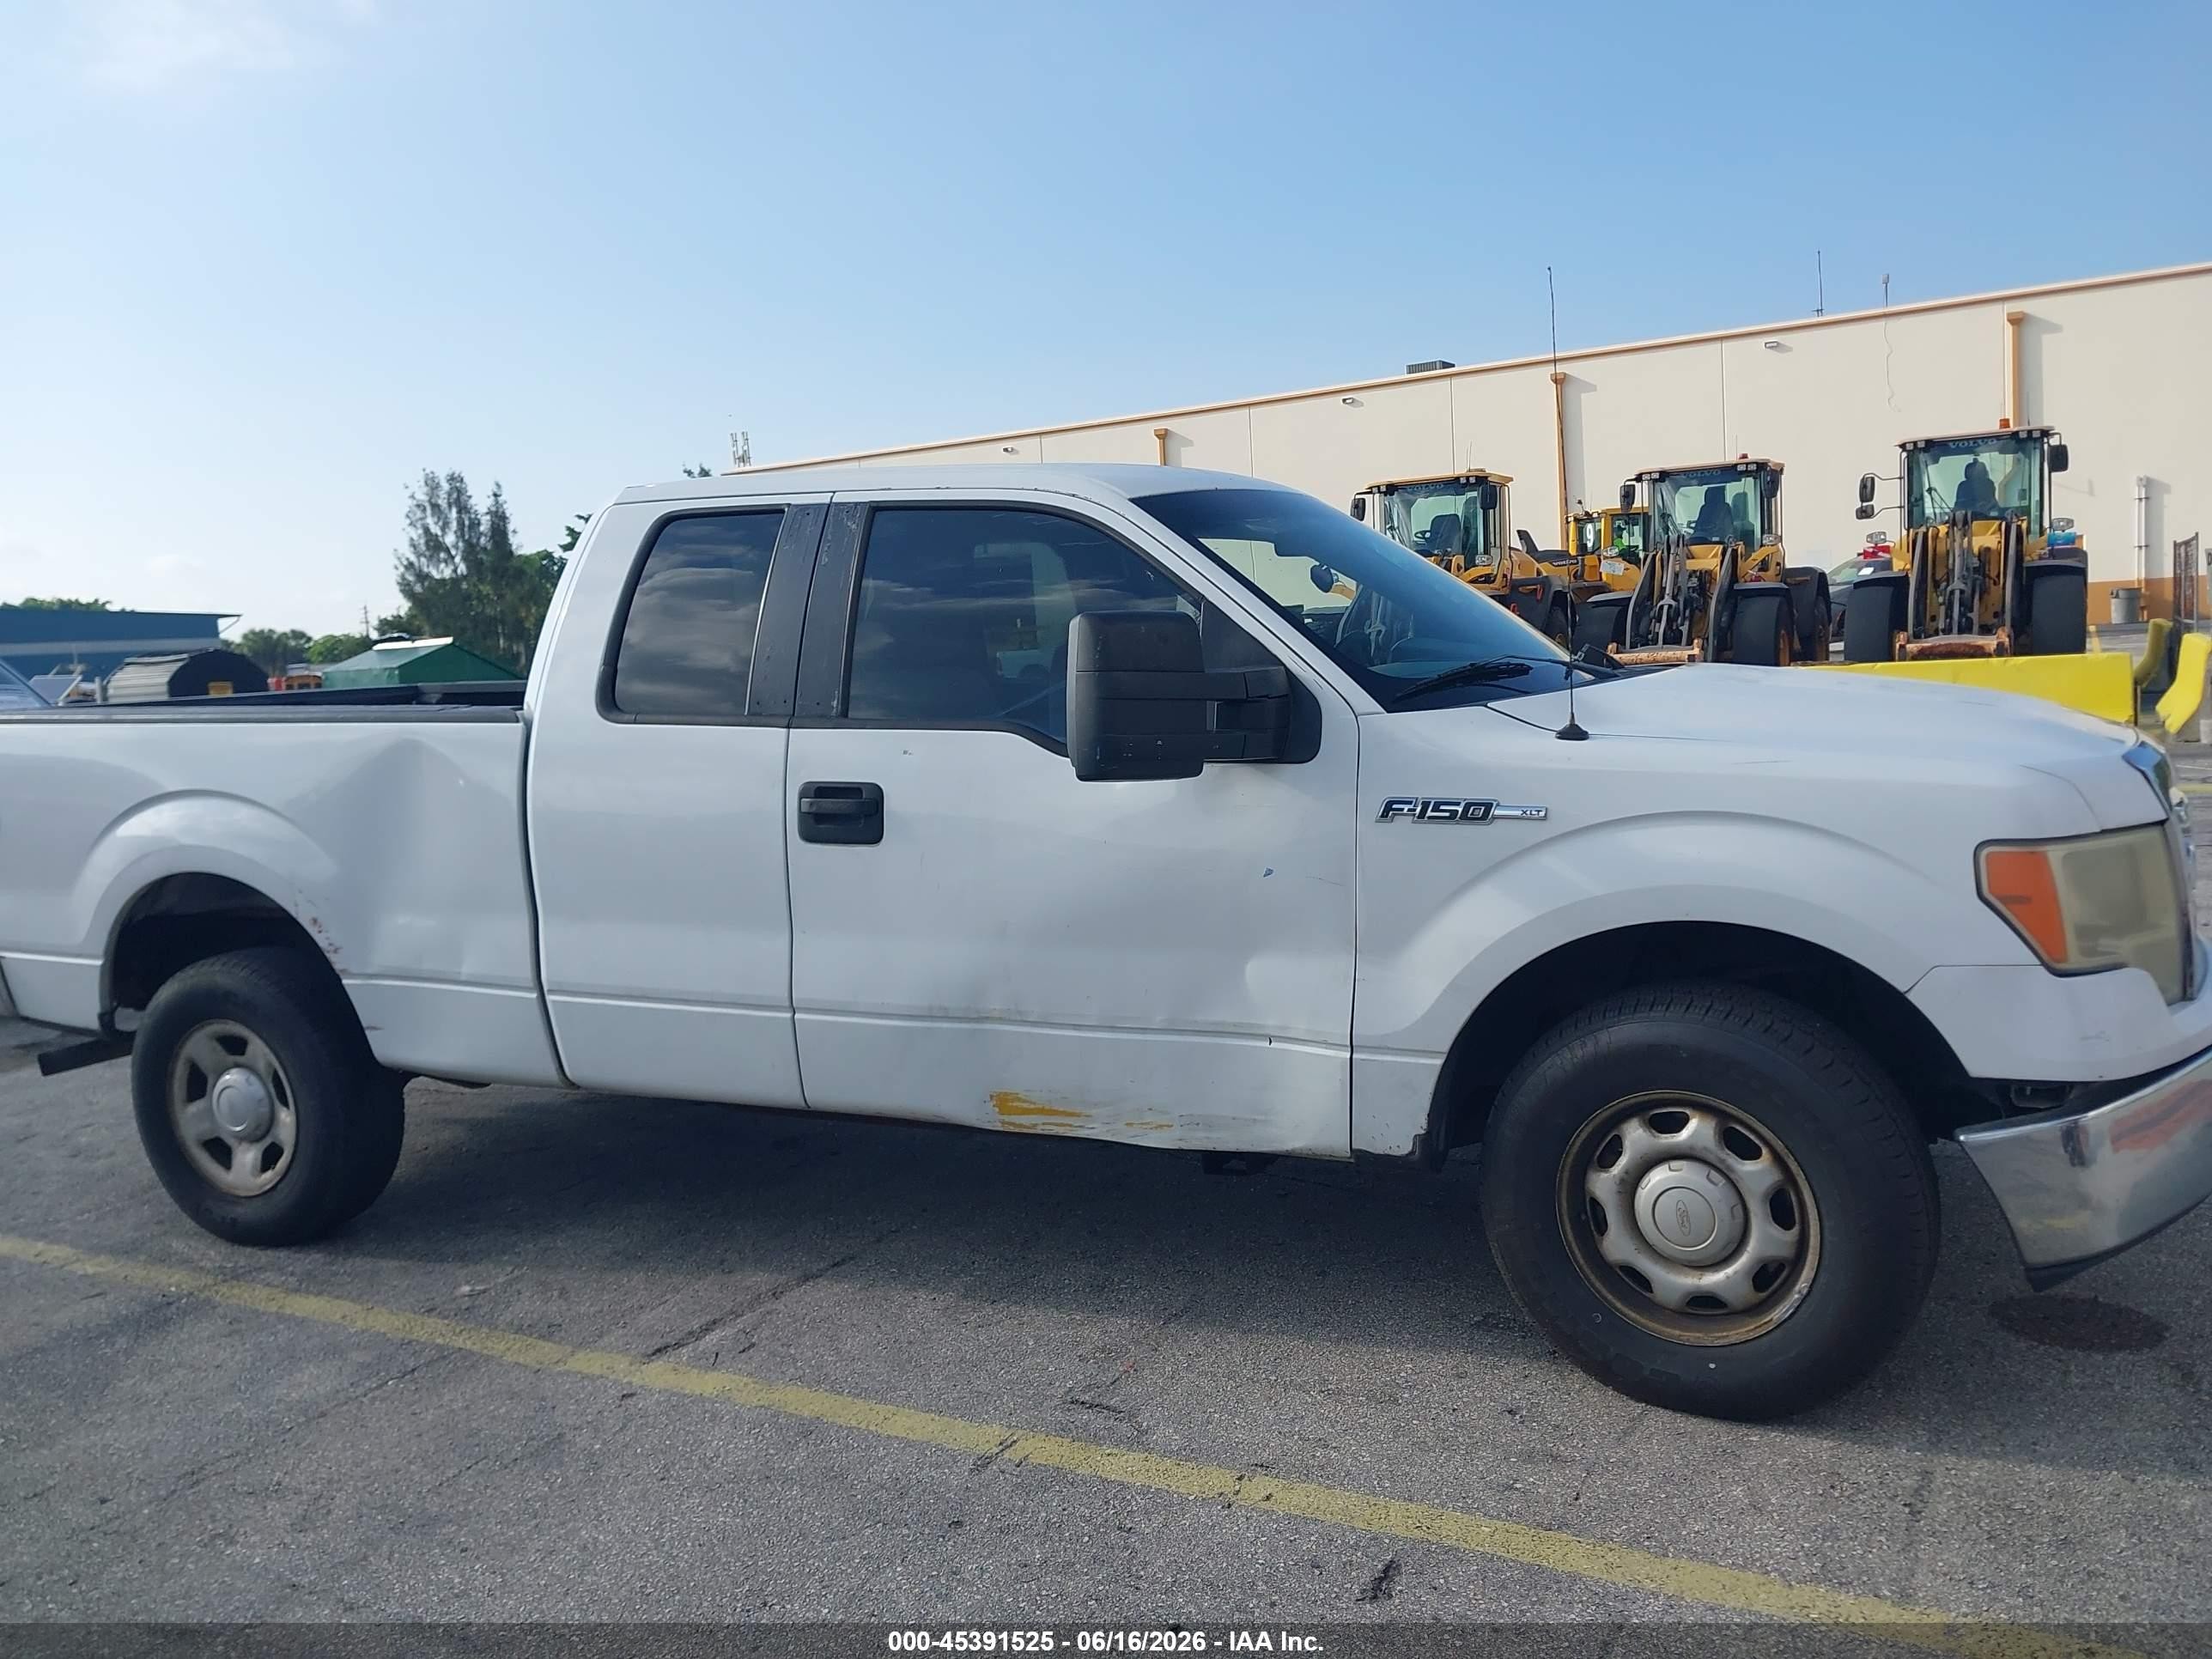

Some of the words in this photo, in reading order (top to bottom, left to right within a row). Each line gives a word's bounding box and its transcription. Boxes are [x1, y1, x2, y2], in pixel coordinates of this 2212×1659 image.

[1950, 438, 1997, 449] VOLVO
[1586, 523, 1594, 548] 9
[1375, 797, 1499, 825] F-150
[1520, 808, 1543, 817] XLT
